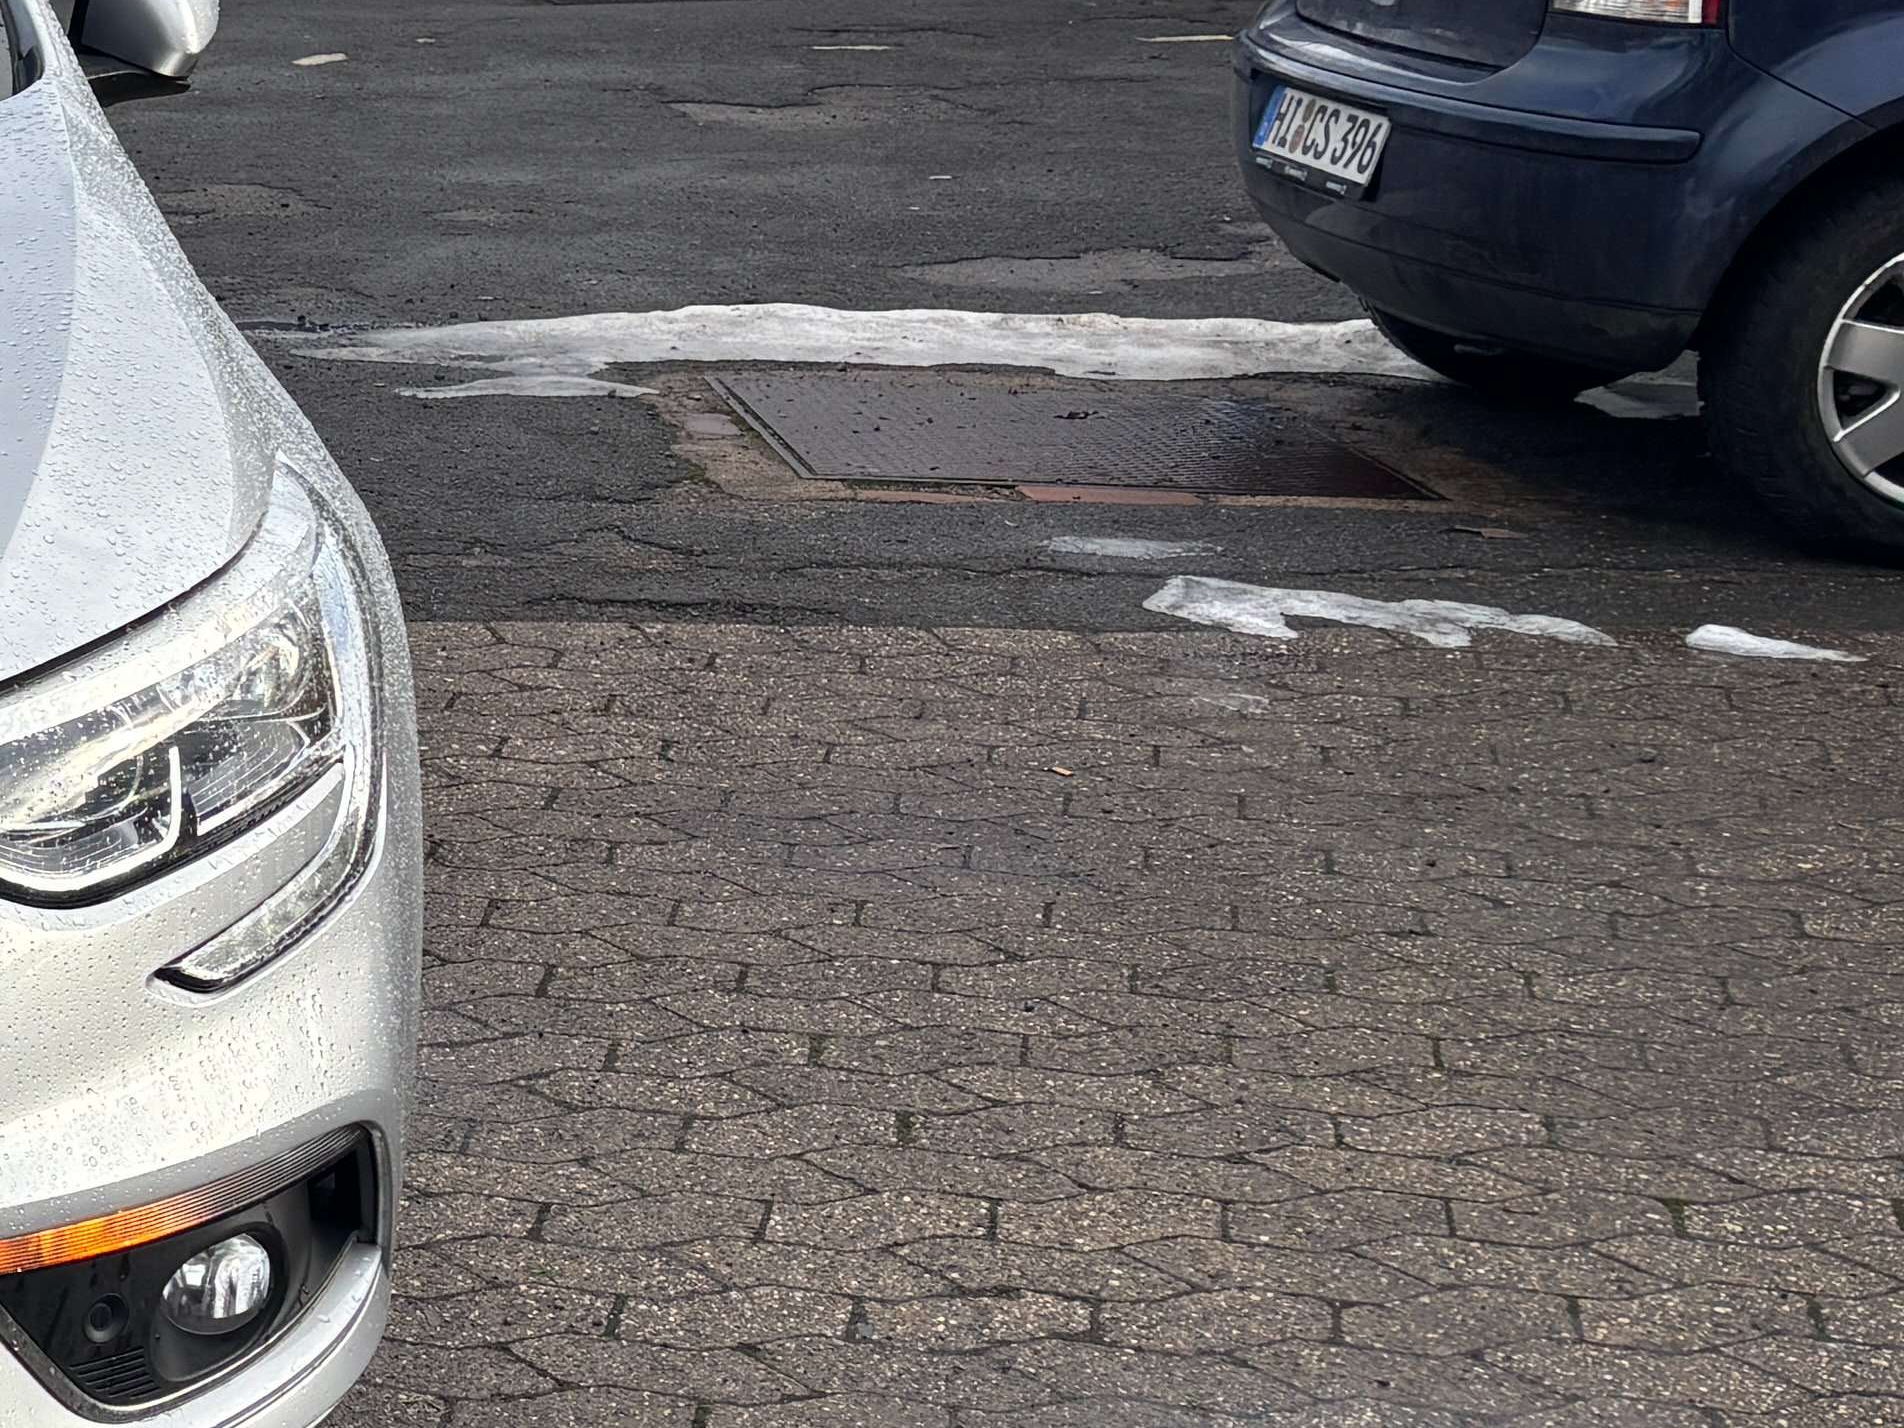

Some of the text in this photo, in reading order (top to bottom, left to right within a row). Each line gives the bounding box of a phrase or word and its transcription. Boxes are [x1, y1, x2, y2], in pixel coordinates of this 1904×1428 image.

[1265, 94, 1383, 174] HI CS 396
